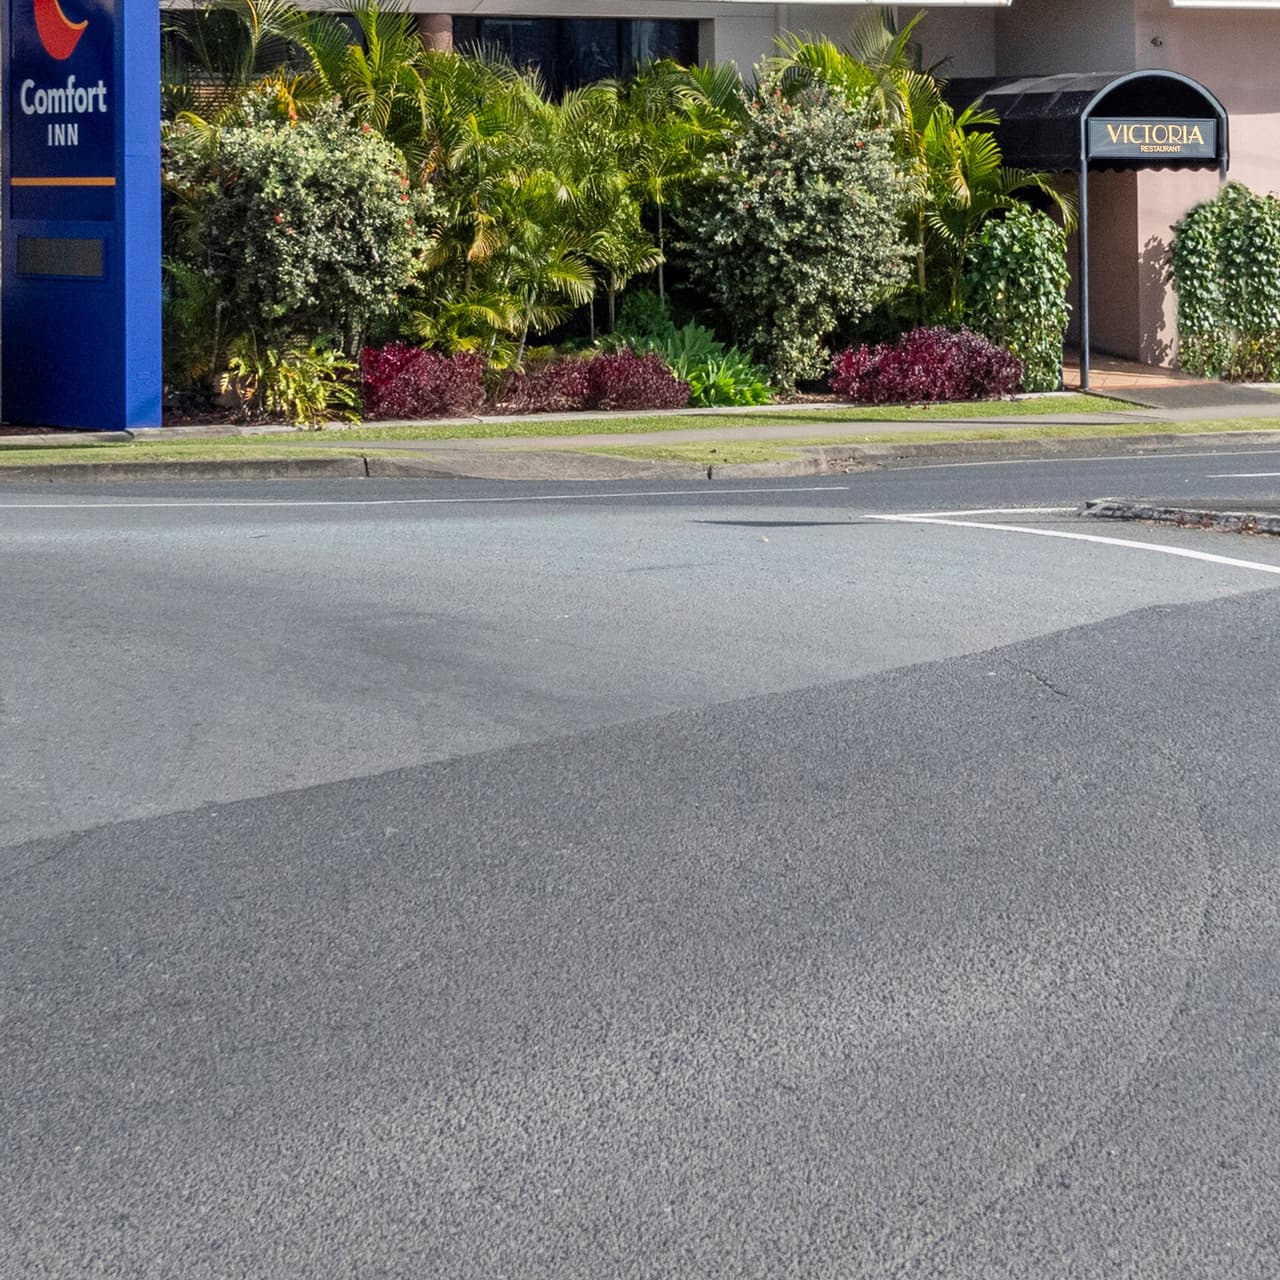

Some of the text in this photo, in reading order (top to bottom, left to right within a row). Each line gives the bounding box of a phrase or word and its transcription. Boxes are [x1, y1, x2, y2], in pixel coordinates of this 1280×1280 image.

[20, 74, 108, 116] Comfort
[47, 123, 79, 146] INN
[1106, 124, 1205, 145] VICTORIA
[1140, 145, 1182, 153] RESTAURANT
